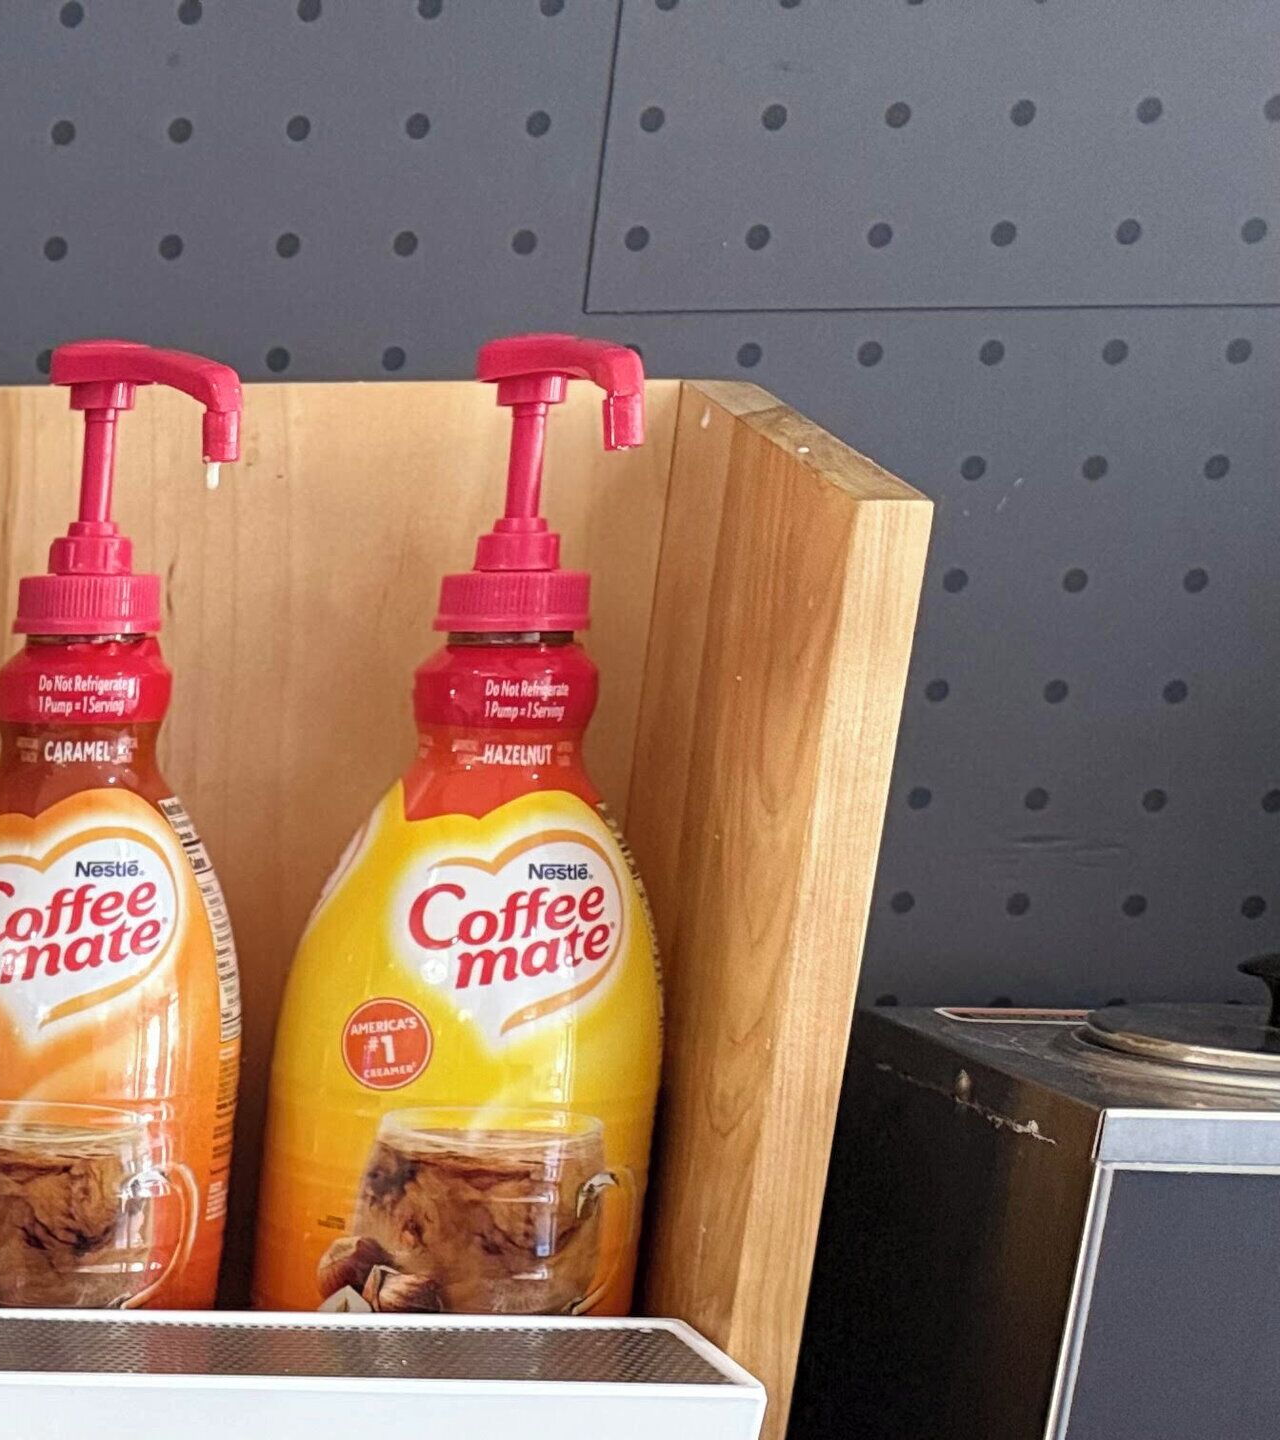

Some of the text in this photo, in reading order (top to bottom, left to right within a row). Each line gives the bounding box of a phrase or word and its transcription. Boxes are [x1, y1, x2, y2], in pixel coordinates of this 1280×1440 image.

[39, 675, 128, 695] Do Not Refrigerate
[485, 680, 569, 701] Do Not Refrigerate
[45, 697, 72, 716] Pump
[89, 697, 125, 716] Serving
[491, 702, 518, 722] Pump
[533, 702, 565, 722] Serving
[44, 741, 111, 762] CARAMEL
[484, 744, 553, 765] HAZELNUT
[74, 859, 140, 879] Nestlé
[528, 861, 590, 881] Nestlé
[408, 882, 605, 951] Coffee
[0, 917, 163, 985] mate
[455, 923, 612, 990] mate
[350, 1016, 418, 1036] AMERICA'S
[368, 1035, 396, 1064] #1
